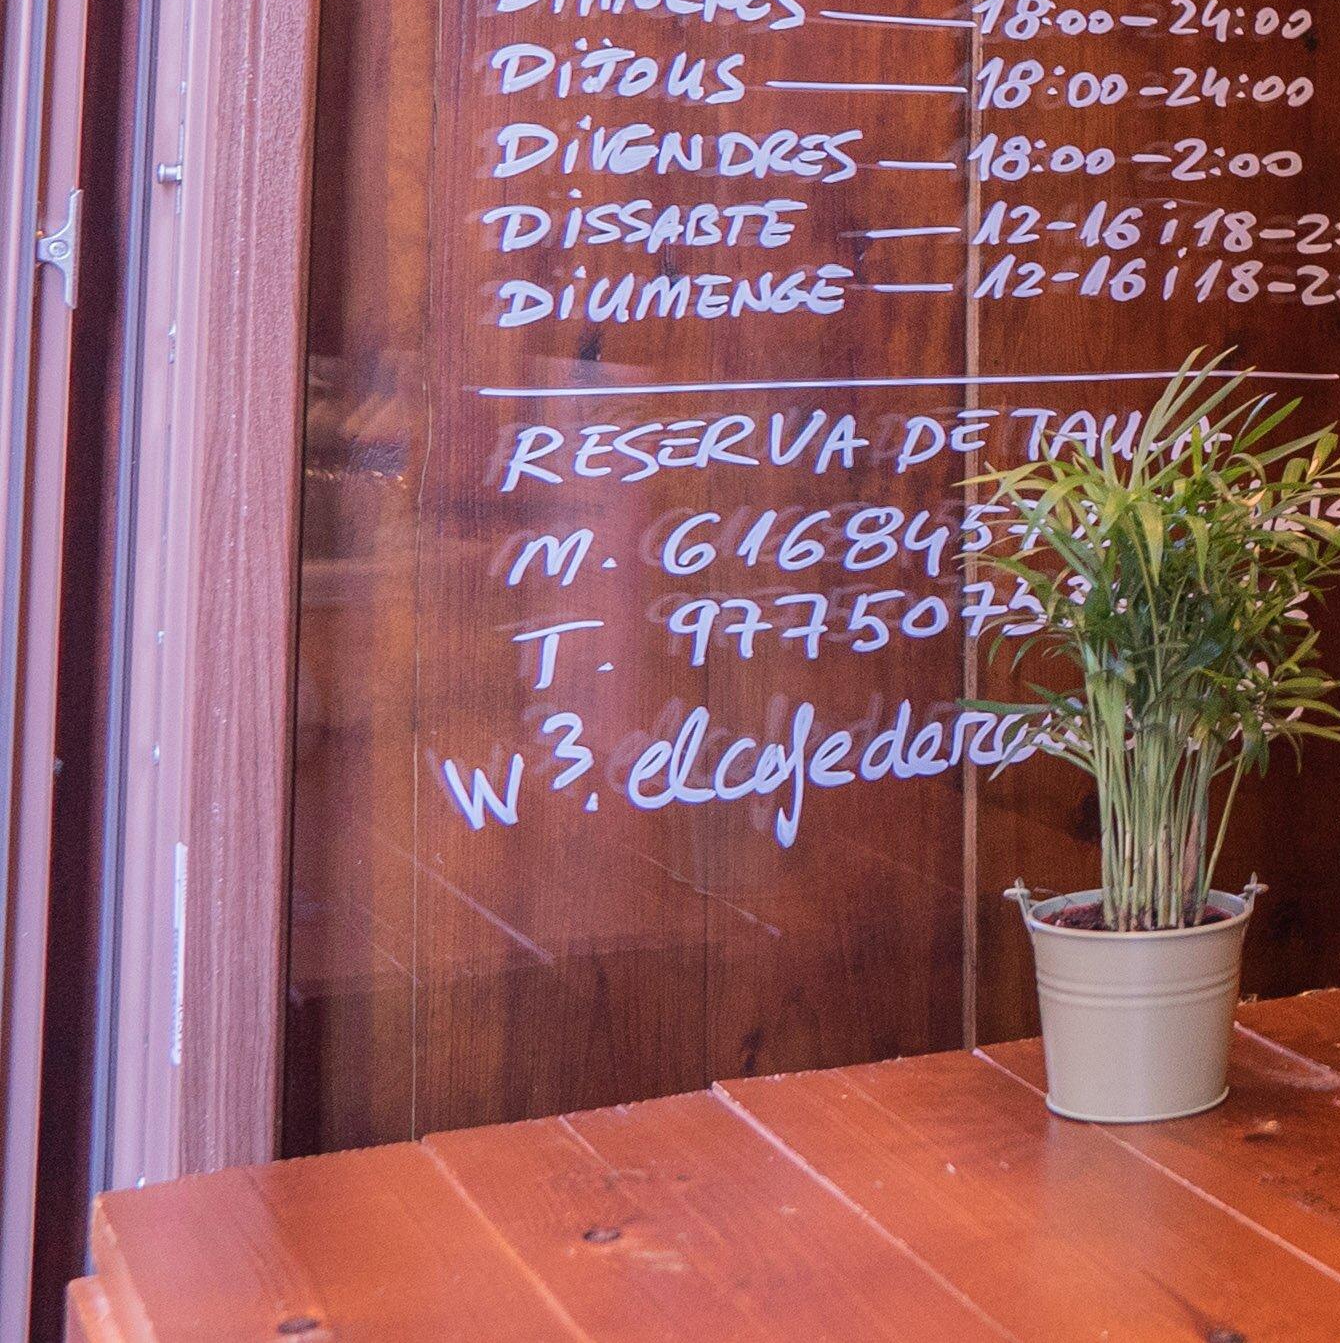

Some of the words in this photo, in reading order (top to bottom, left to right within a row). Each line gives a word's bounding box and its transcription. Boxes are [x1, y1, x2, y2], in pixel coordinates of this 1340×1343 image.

[501, 409, 869, 492] RESERVA
[896, 409, 1000, 475] DE
[507, 528, 618, 588] M.
[512, 619, 615, 691] T.
